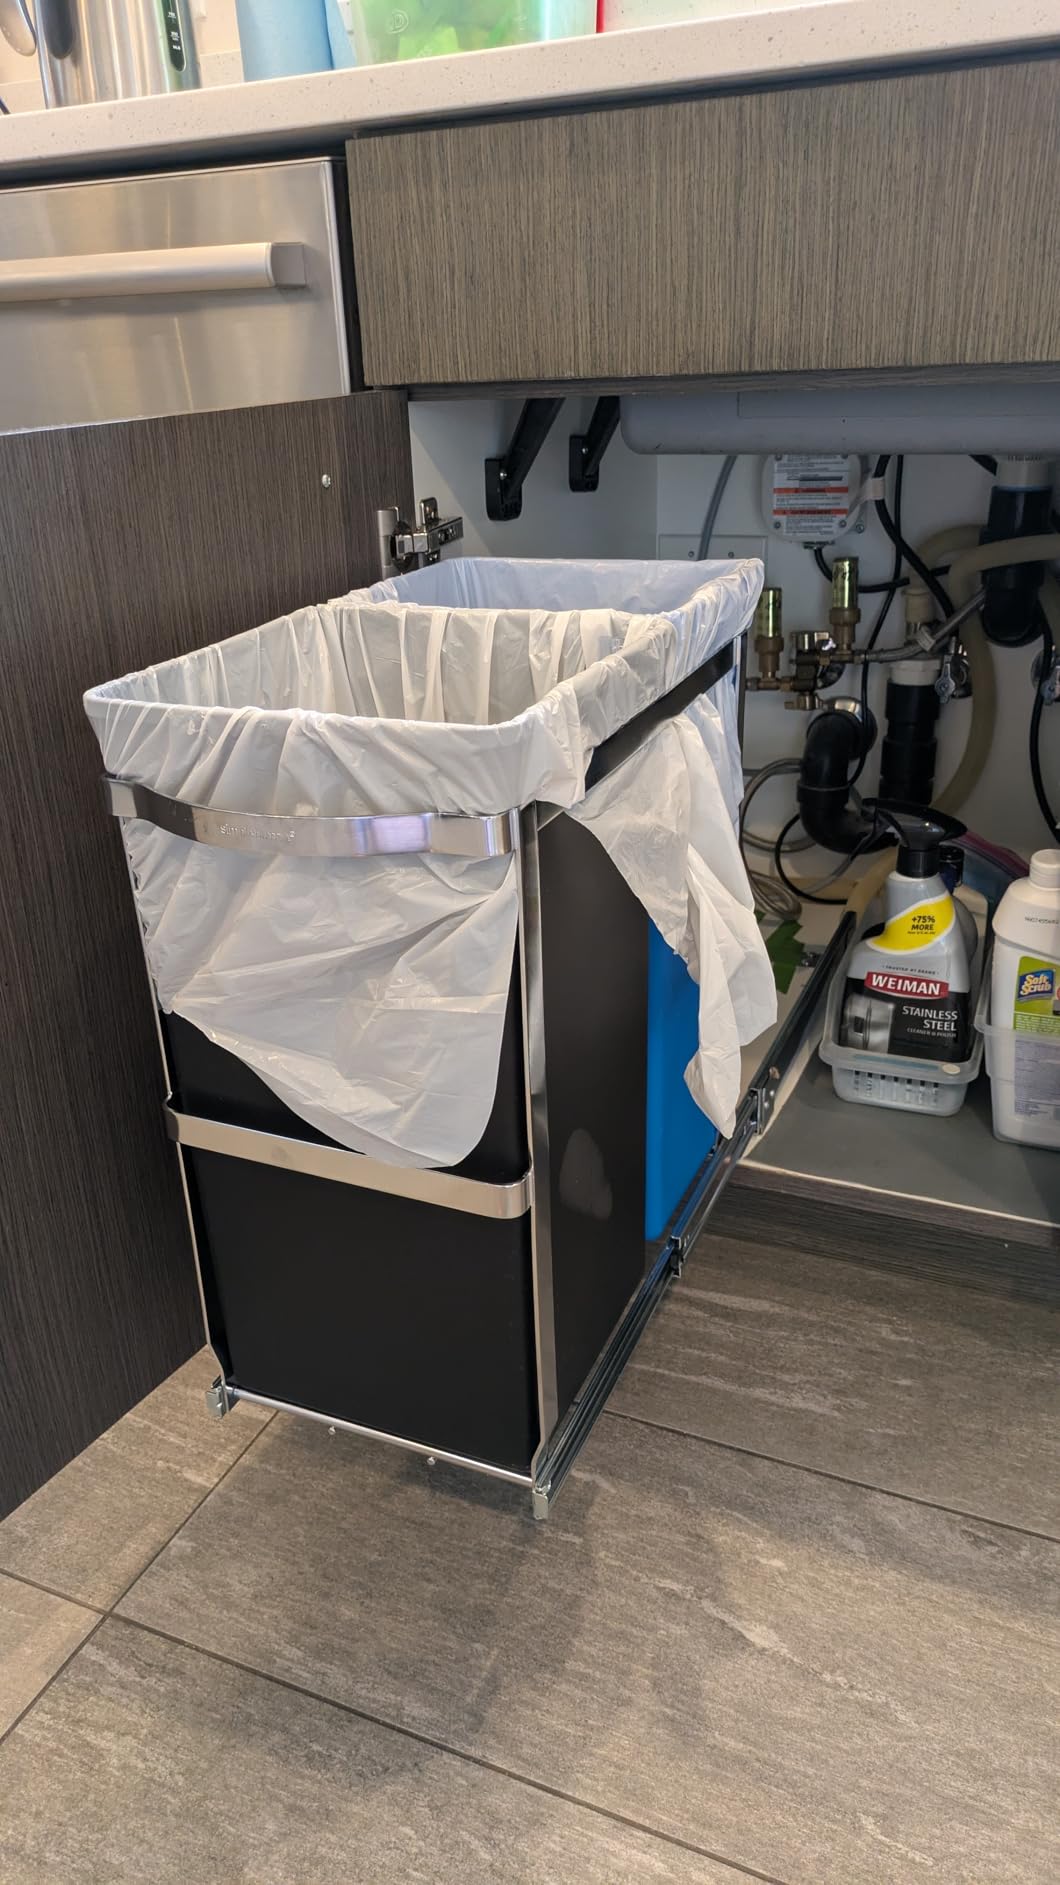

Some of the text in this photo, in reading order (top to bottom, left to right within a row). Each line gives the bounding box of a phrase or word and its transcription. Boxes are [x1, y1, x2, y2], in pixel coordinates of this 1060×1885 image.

[911, 915, 936, 924] +75%
[911, 923, 935, 931] MORE
[871, 973, 940, 996] WEIMAN
[1025, 974, 1049, 986] Soft
[1020, 983, 1052, 996] Scrub
[902, 1005, 958, 1021] STAINLESS
[923, 1019, 957, 1032] STEEL
